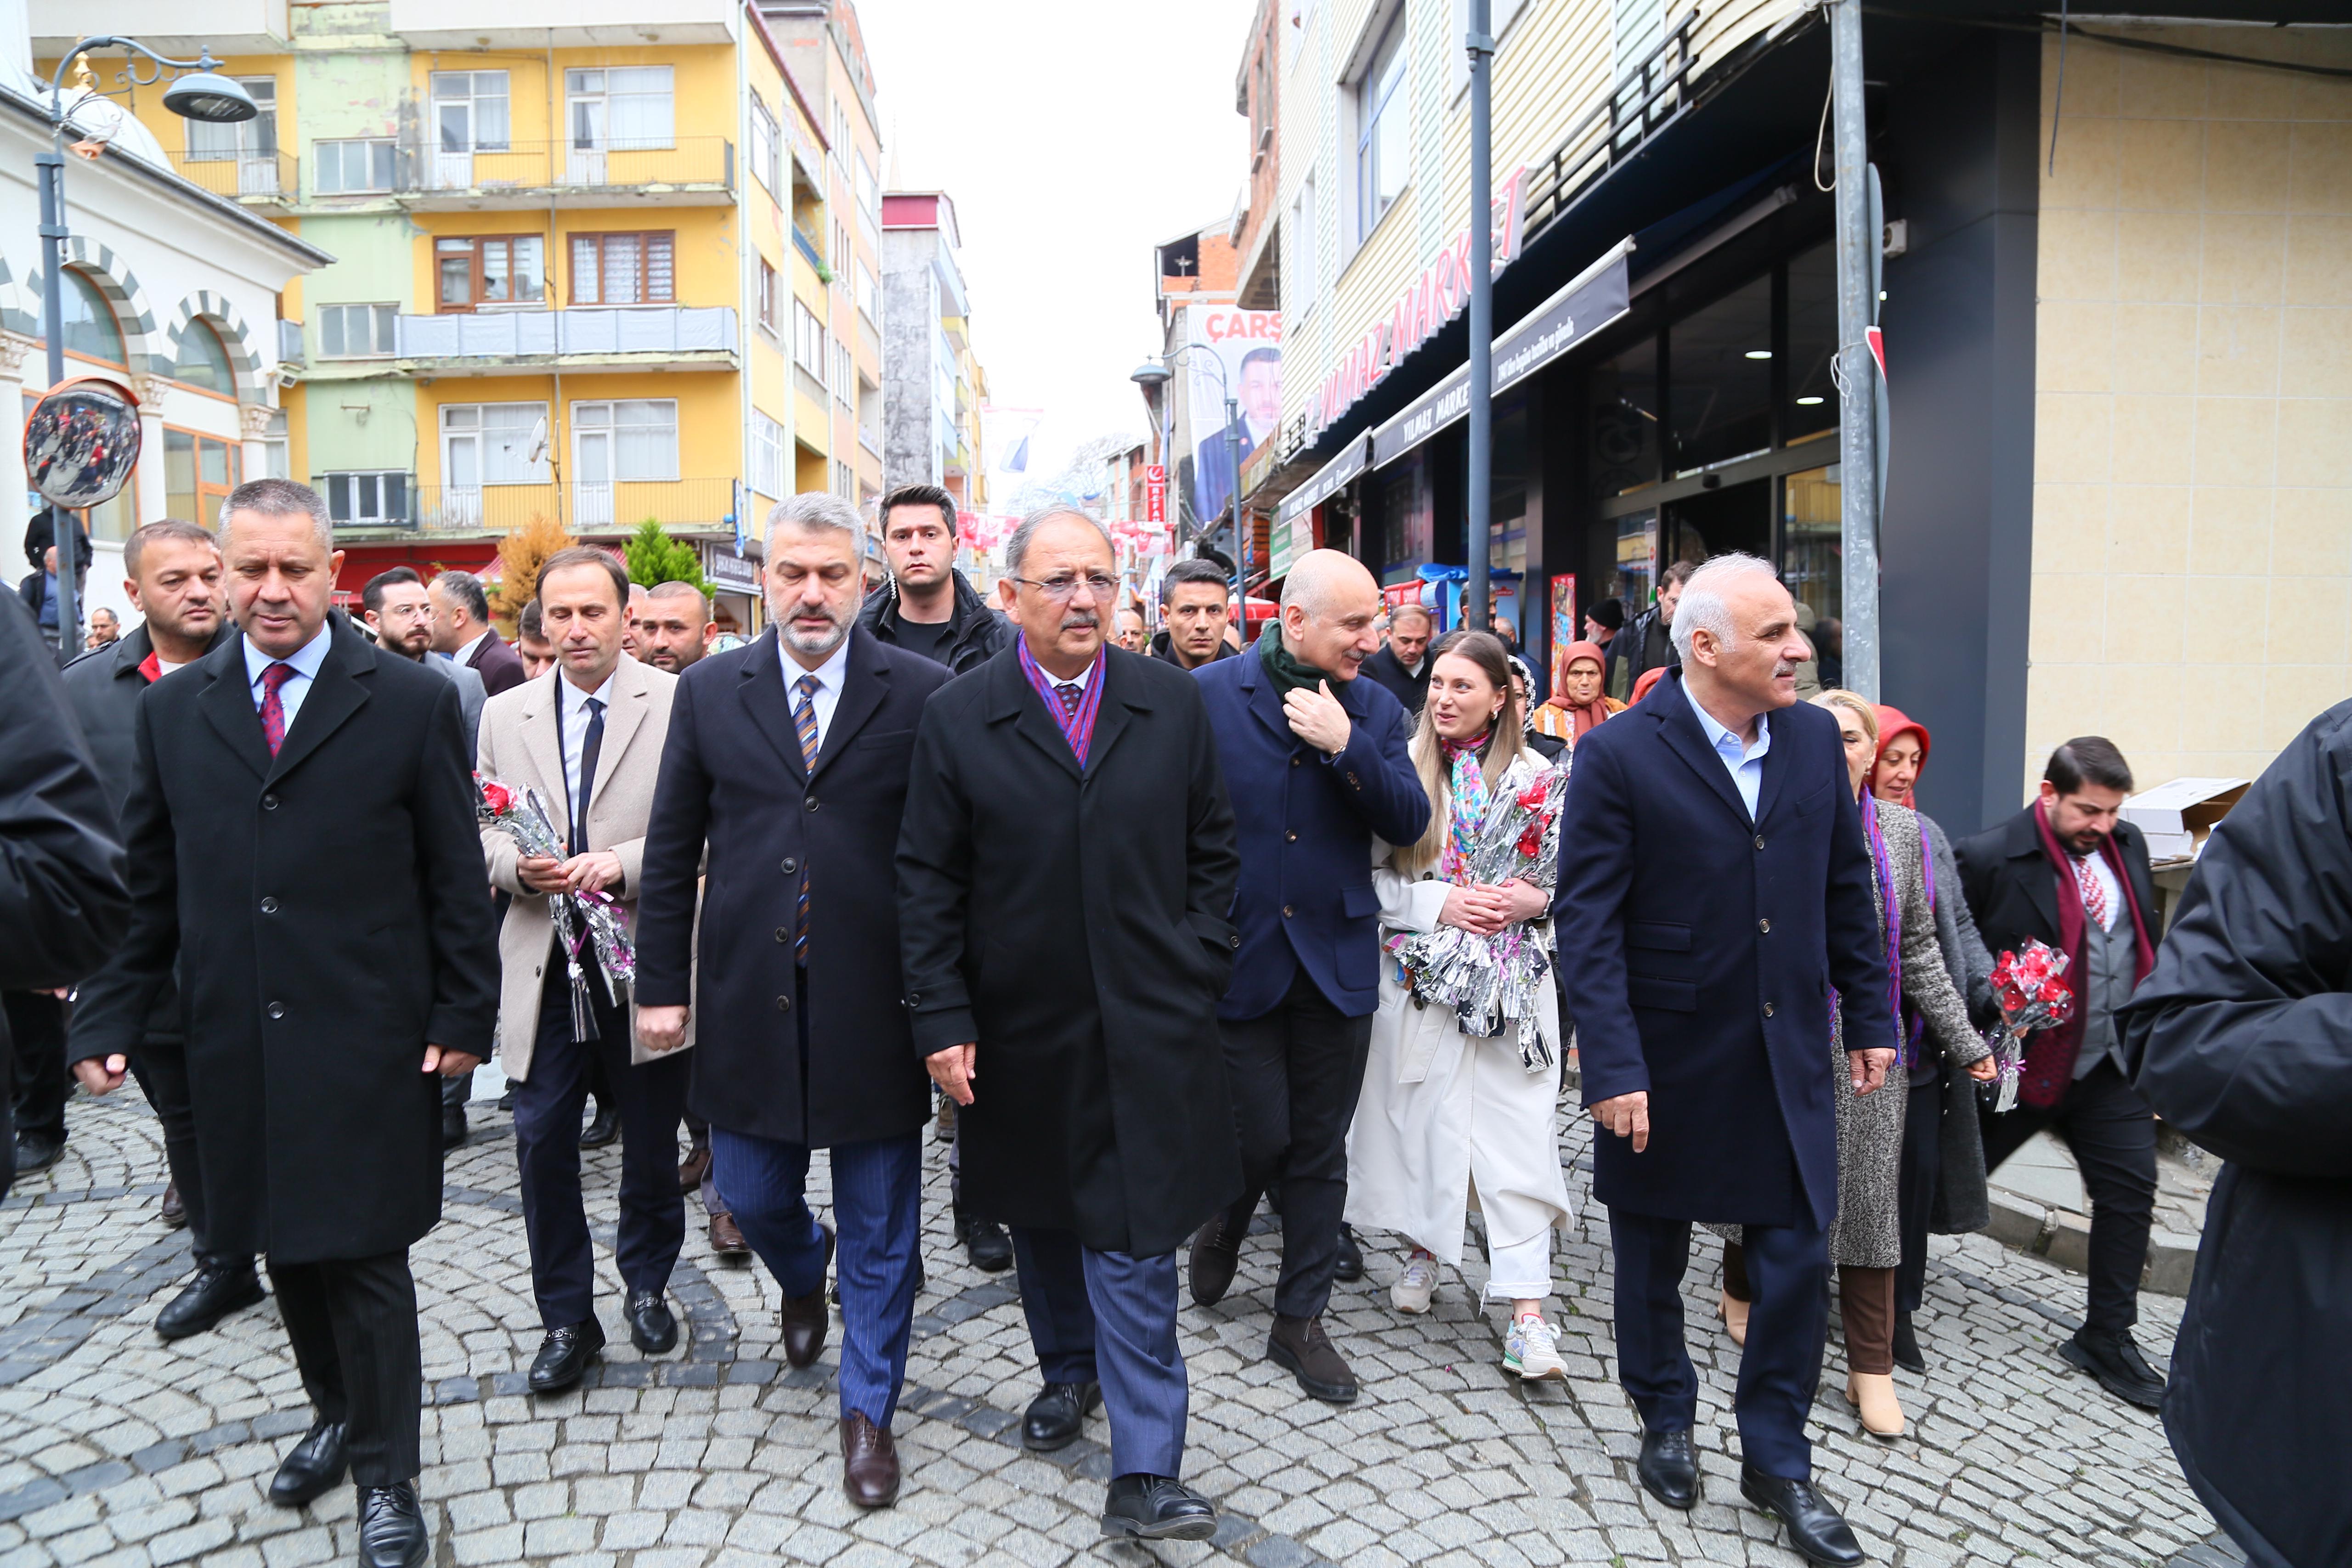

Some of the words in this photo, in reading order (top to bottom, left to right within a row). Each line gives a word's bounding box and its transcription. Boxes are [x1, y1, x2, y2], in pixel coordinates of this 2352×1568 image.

[1318, 321, 1385, 432] YILMAZ
[1390, 164, 1527, 366] MARKT
[1403, 408, 1432, 444] YILMAZ
